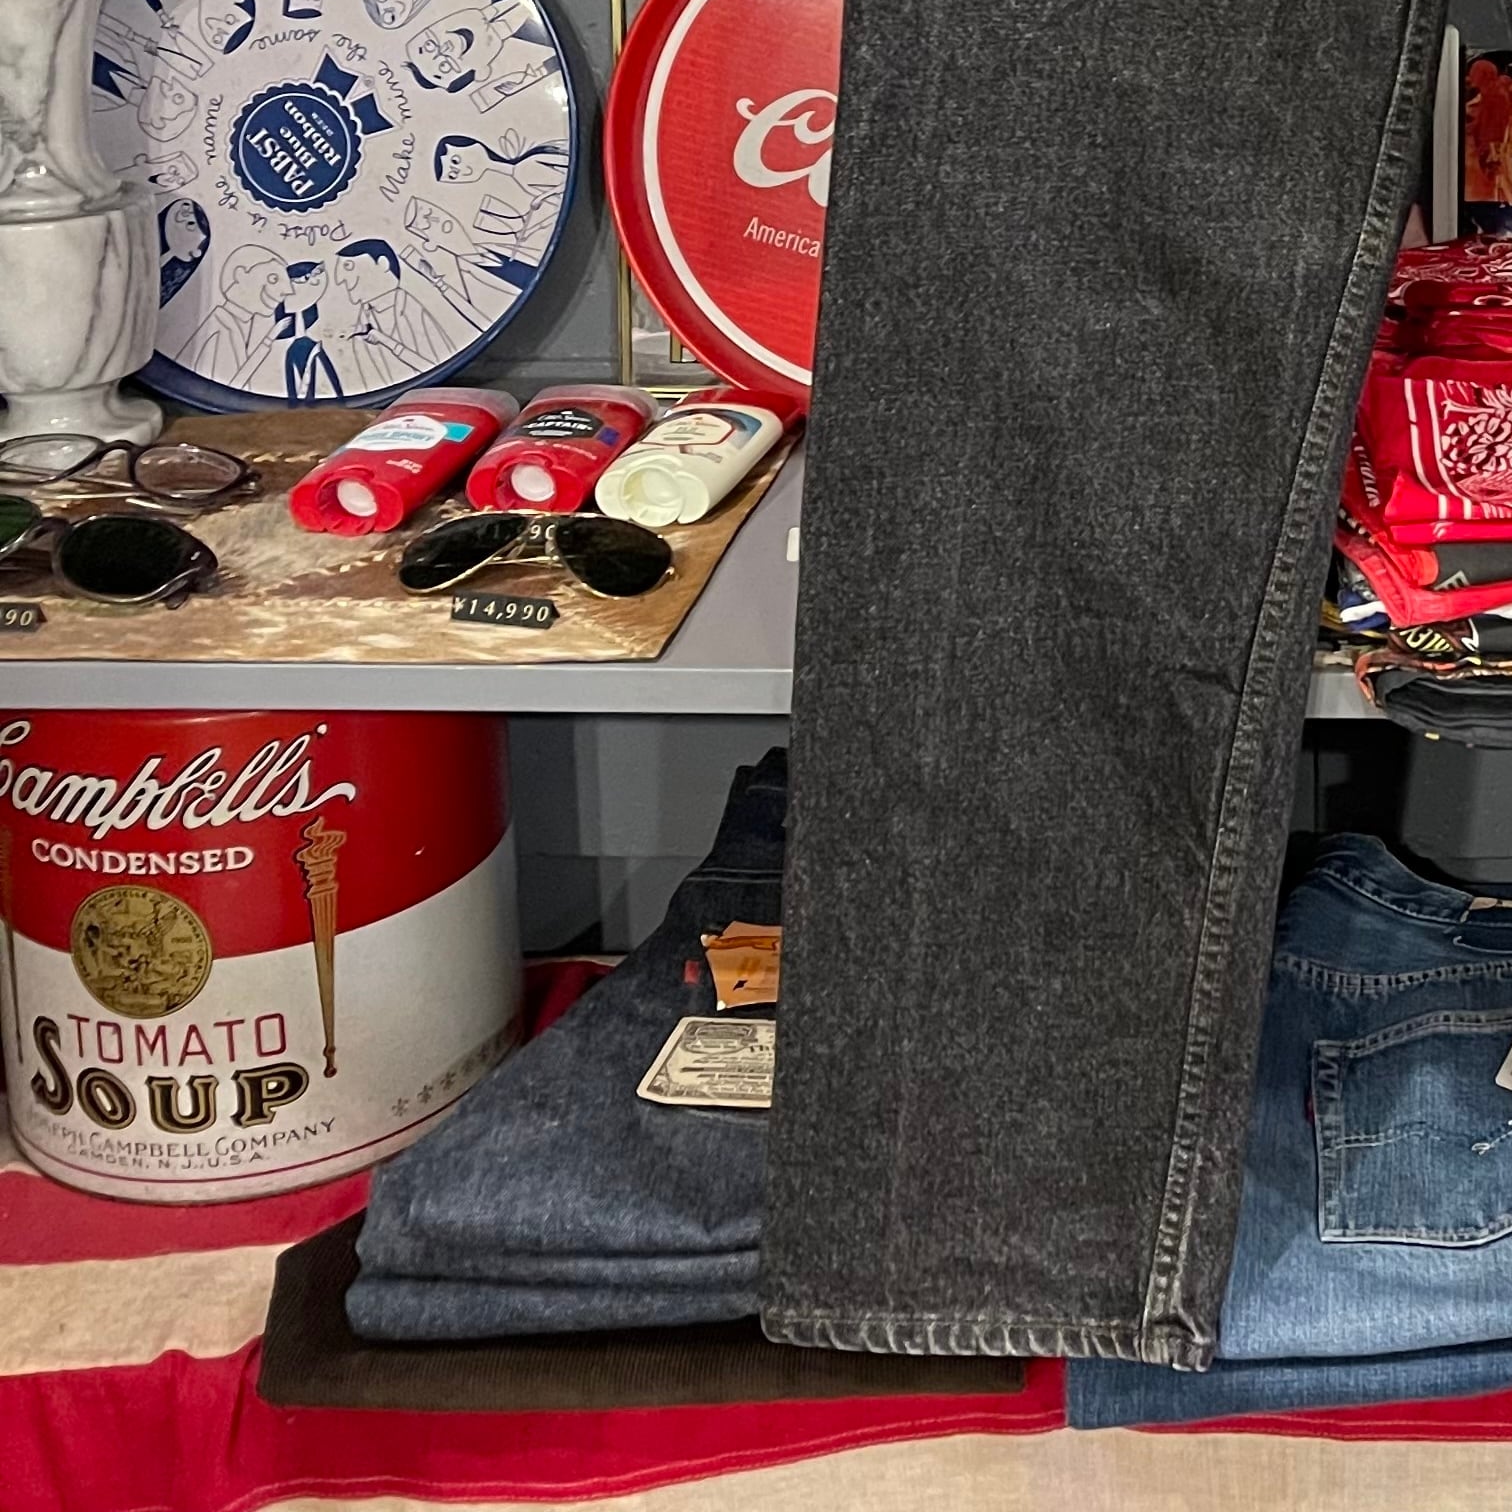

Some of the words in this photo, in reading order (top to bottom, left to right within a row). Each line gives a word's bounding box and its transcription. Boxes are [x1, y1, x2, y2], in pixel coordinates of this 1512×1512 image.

[249, 28, 322, 50] same
[332, 33, 368, 62] the
[378, 59, 413, 123] mine
[203, 93, 224, 166] name
[279, 126, 319, 170] Blue
[283, 99, 342, 167] Ribbon
[246, 127, 315, 197] PABST
[378, 132, 416, 203] Make
[215, 175, 239, 211] the
[247, 211, 268, 234] is
[279, 219, 353, 247] Pabst
[454, 596, 549, 622] ¥14,990
[31, 838, 254, 875] CONDENSED
[67, 1012, 288, 1067] TOMATO
[31, 1015, 310, 1134] SOUP
[214, 1116, 337, 1157] COMPANY
